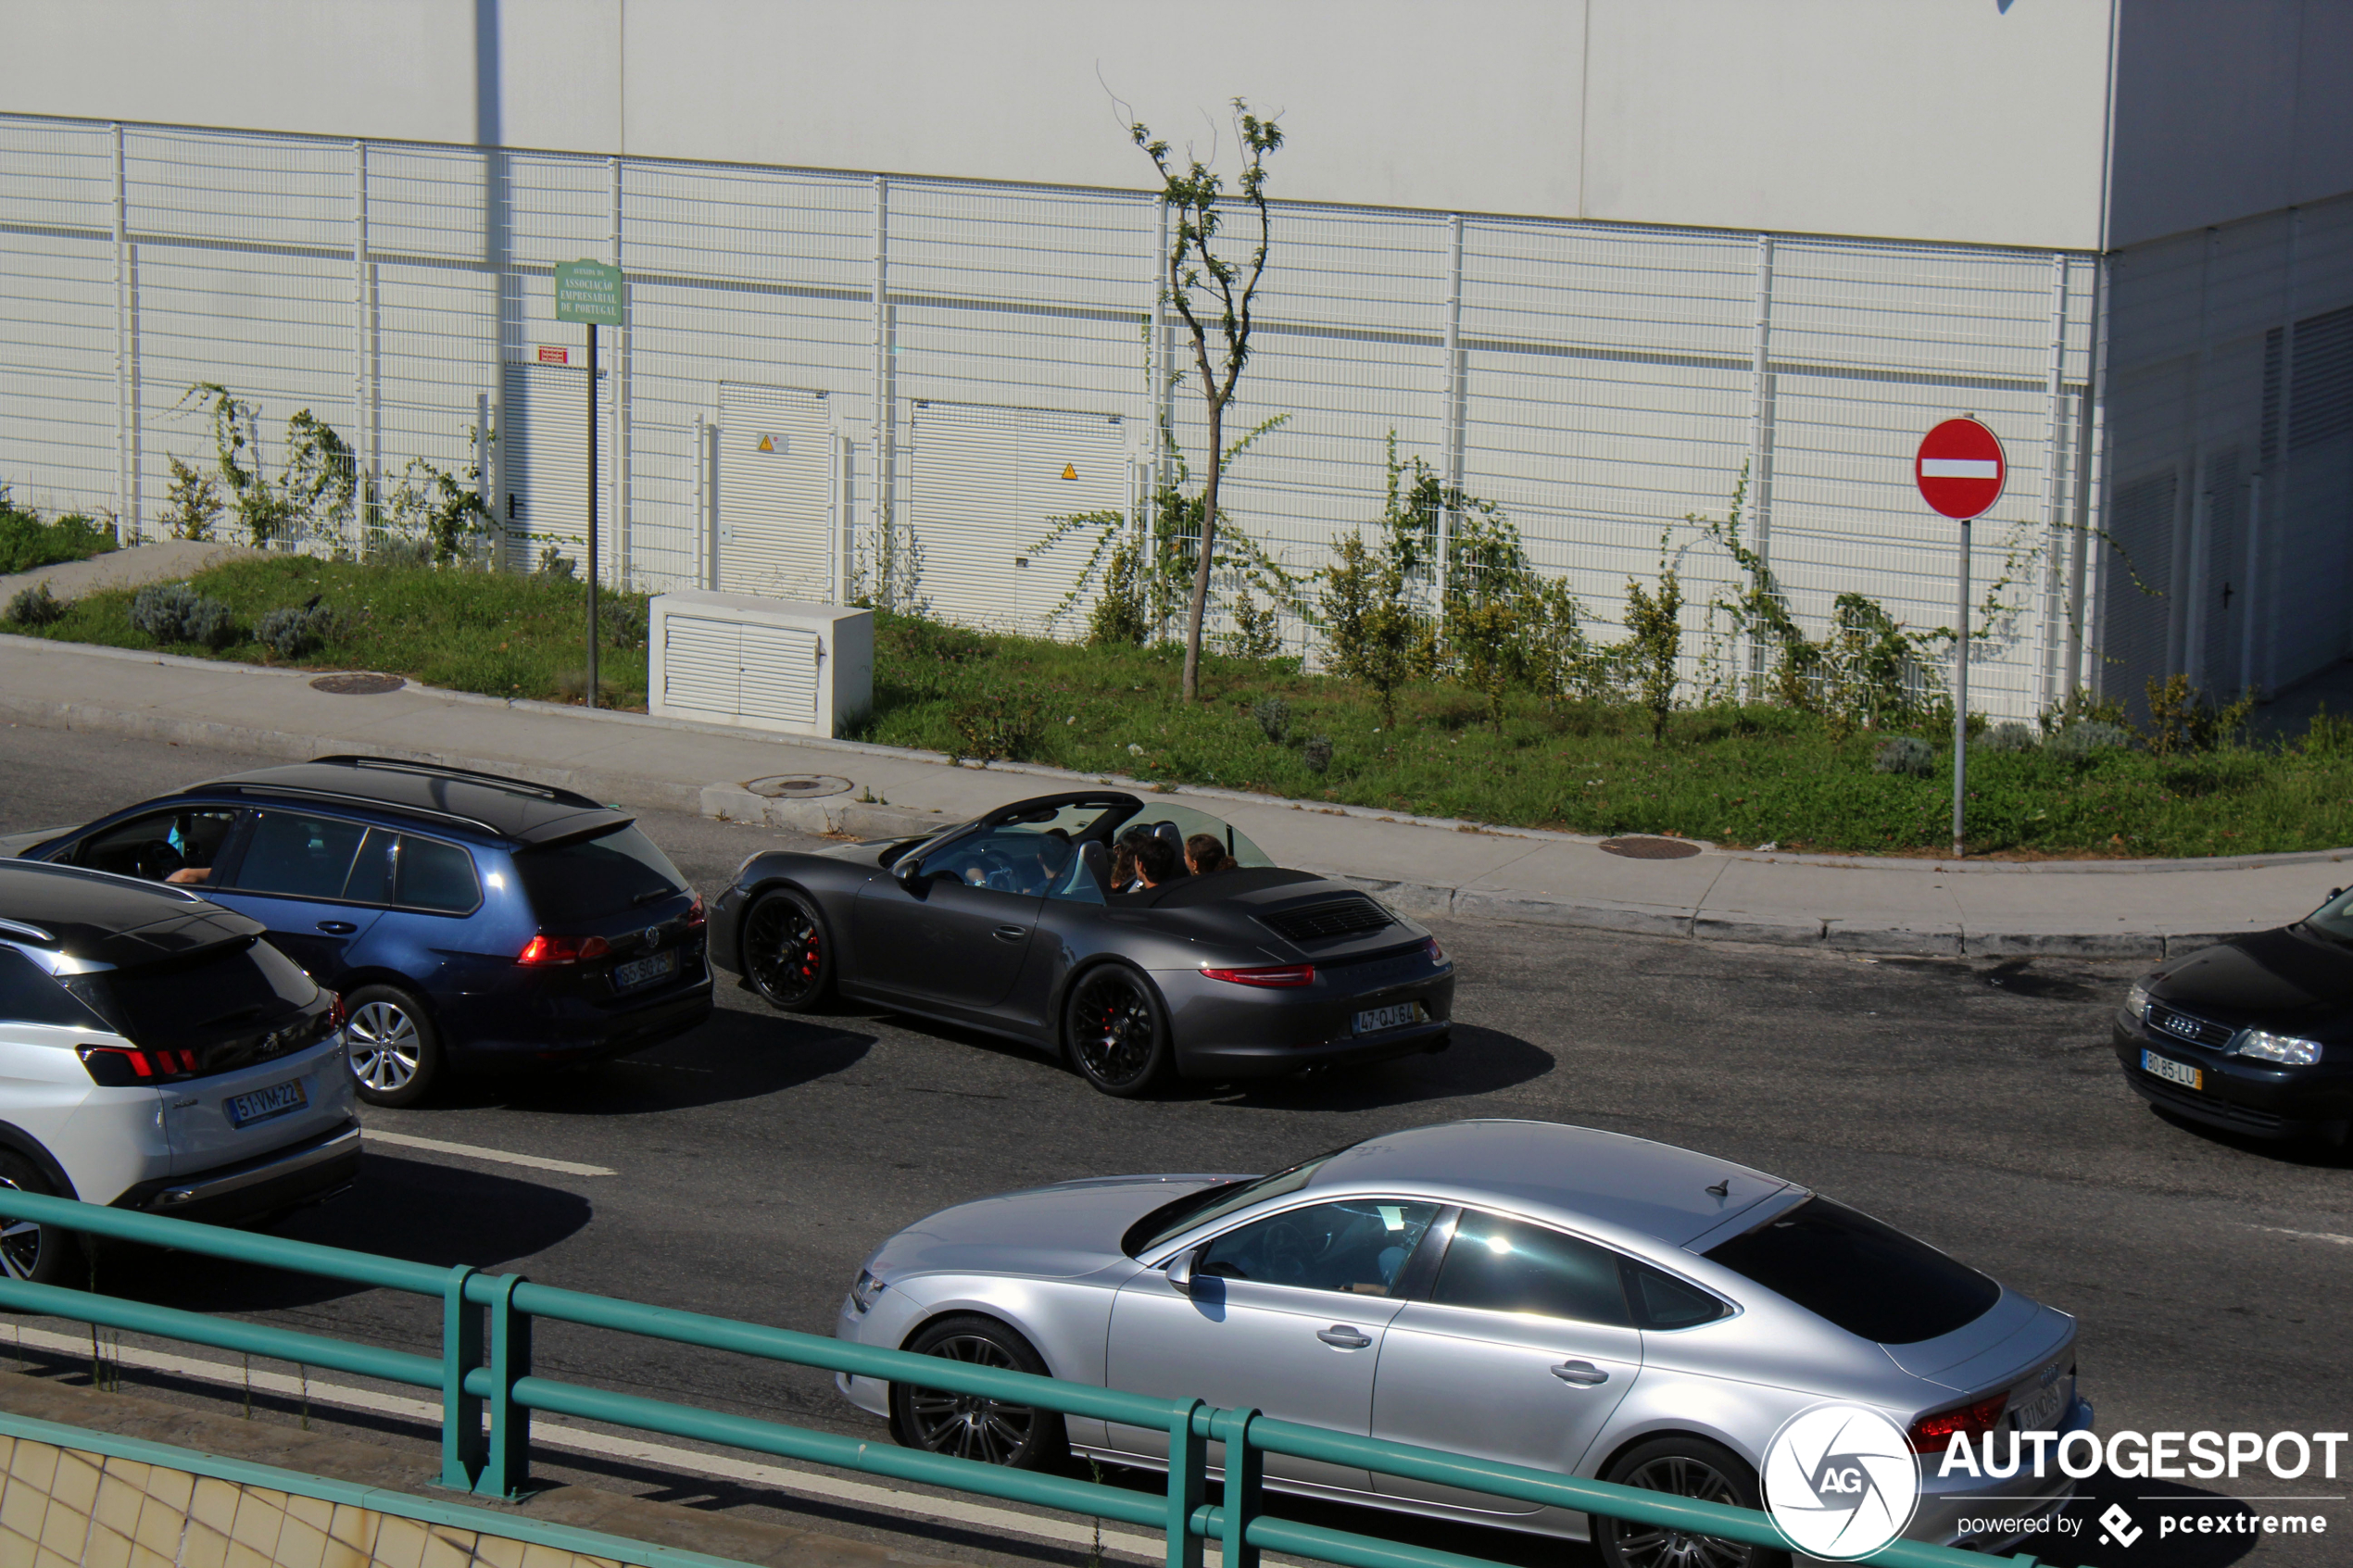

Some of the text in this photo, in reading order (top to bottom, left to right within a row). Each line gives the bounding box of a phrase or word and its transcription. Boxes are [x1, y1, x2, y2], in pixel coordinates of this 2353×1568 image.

[565, 278, 613, 293] ASSOCIAÇÃO
[560, 290, 617, 304] EMPRESARIAL
[560, 302, 617, 316] DE PORTUGAL
